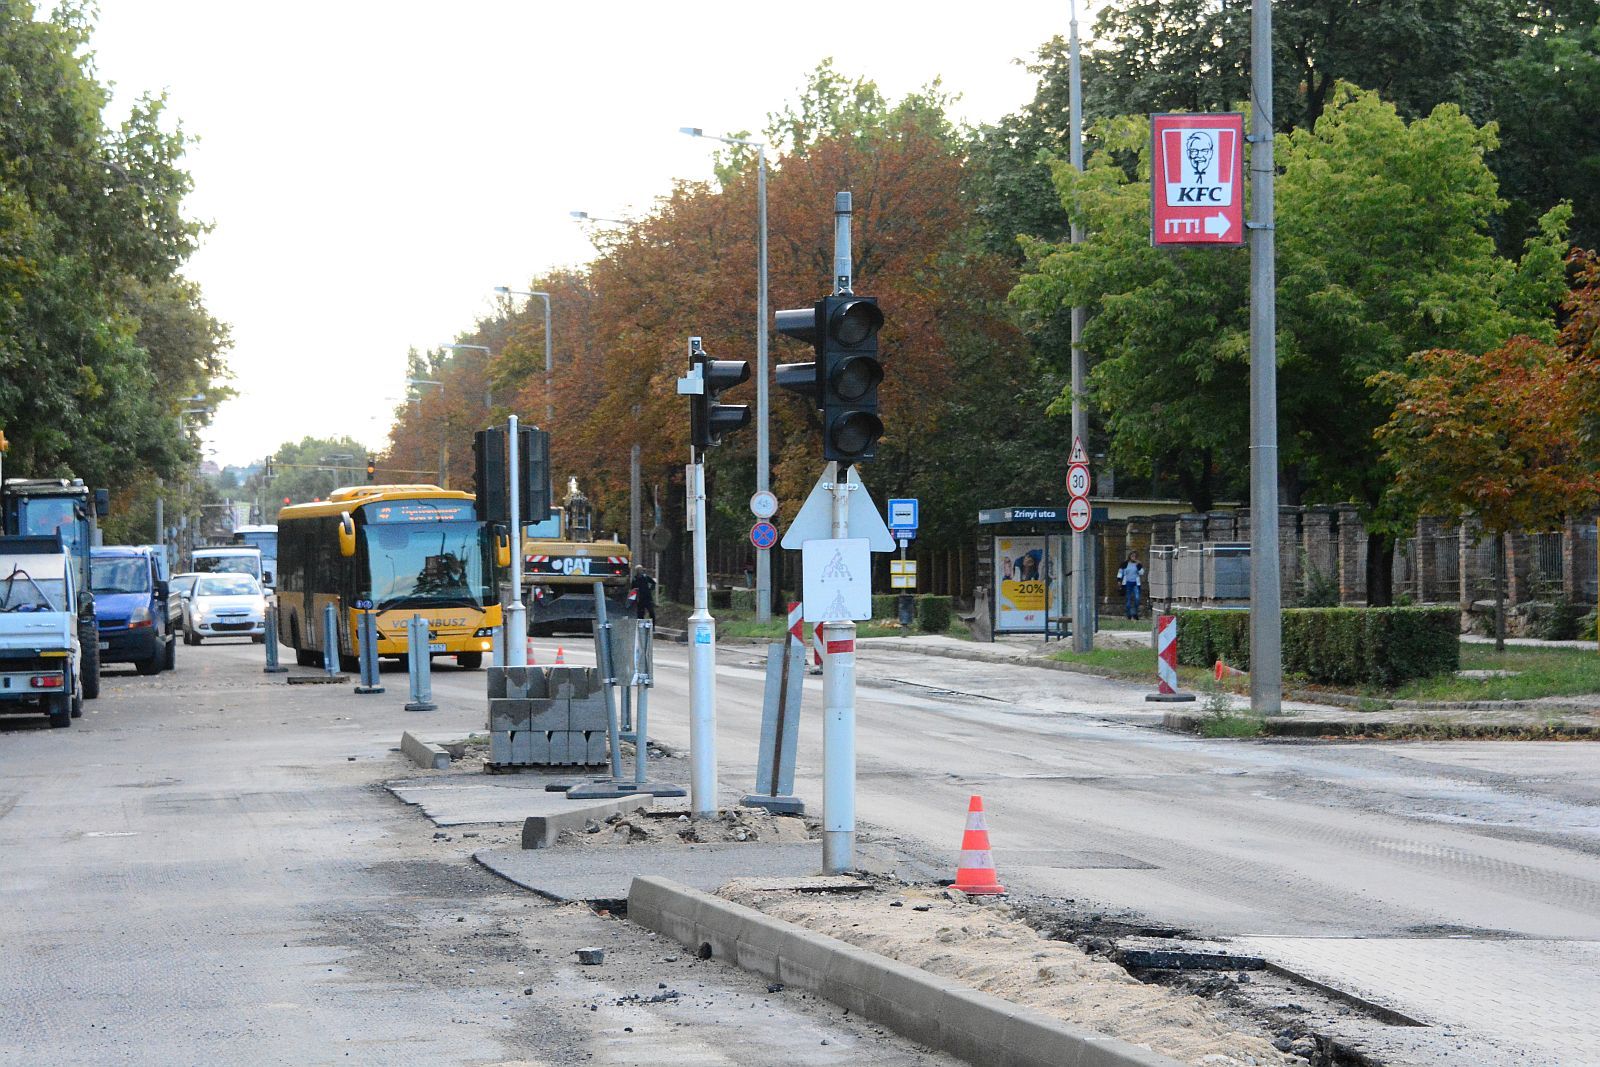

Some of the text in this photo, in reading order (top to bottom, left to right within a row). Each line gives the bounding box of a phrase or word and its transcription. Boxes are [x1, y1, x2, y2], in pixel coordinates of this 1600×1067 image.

[1177, 187, 1222, 202] KFC
[1164, 219, 1200, 234] ITT!
[1072, 475, 1084, 489] 30
[1014, 510, 1037, 520] Zrínyi
[563, 558, 592, 575] CAT
[1014, 584, 1043, 594] -20%
[392, 618, 466, 628] VONBUSZ
